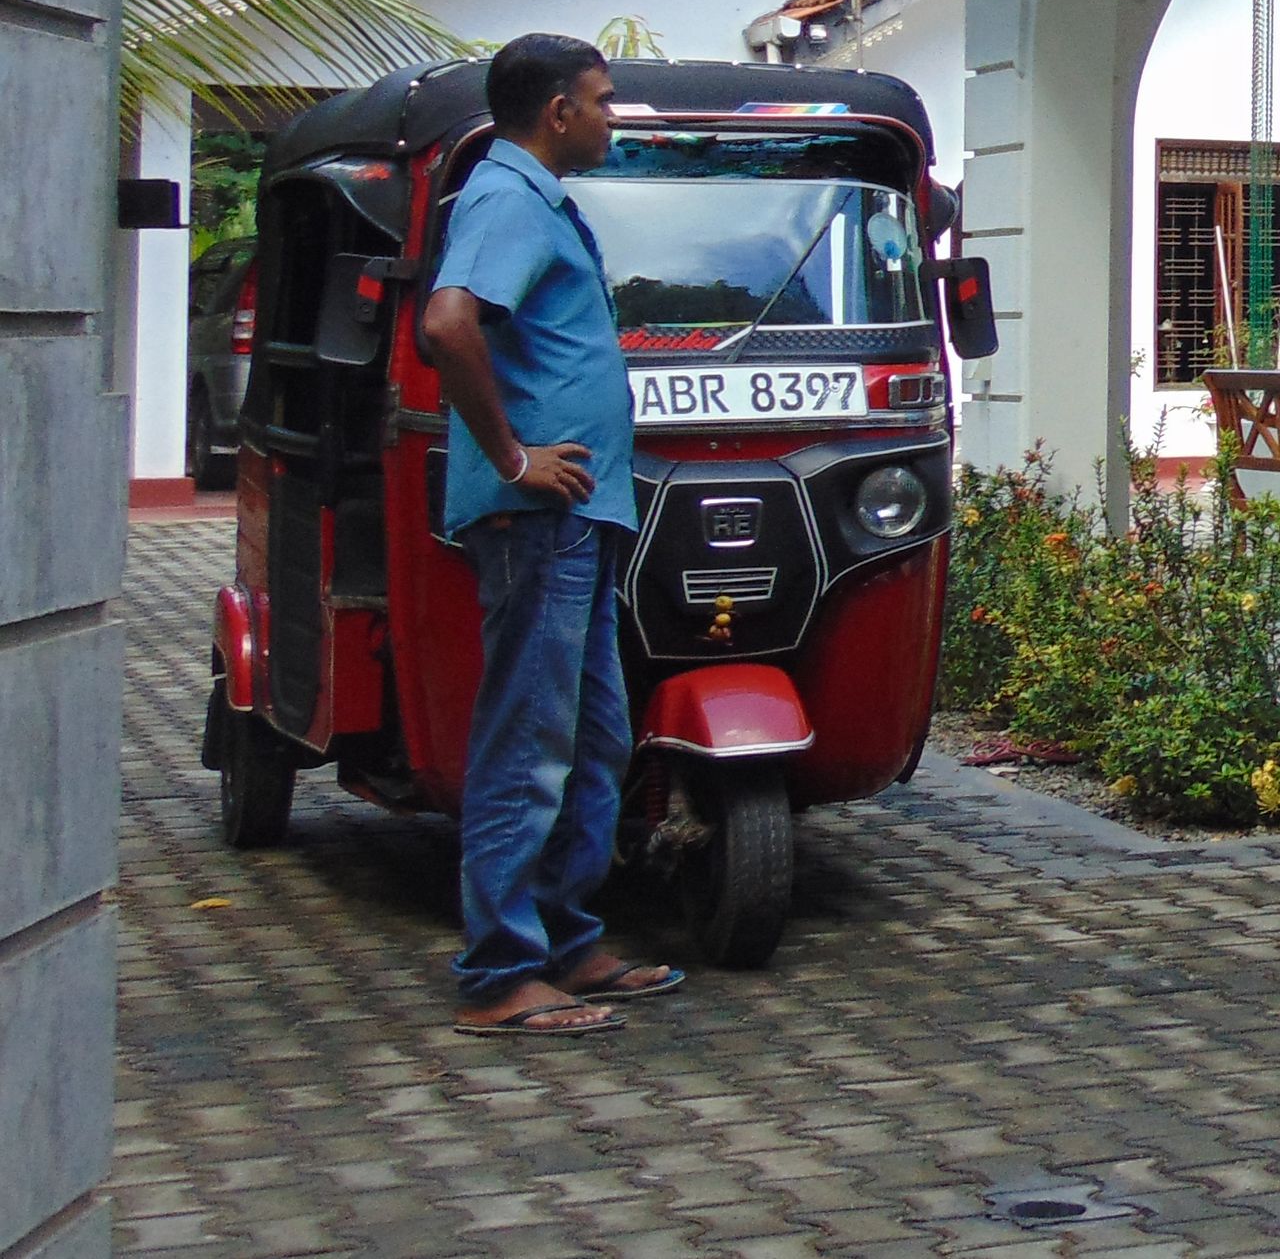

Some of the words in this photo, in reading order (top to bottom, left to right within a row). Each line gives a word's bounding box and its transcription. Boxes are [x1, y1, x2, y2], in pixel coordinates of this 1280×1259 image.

[642, 375, 730, 416] ABR
[750, 372, 857, 412] 8397
[713, 514, 751, 536] RE
